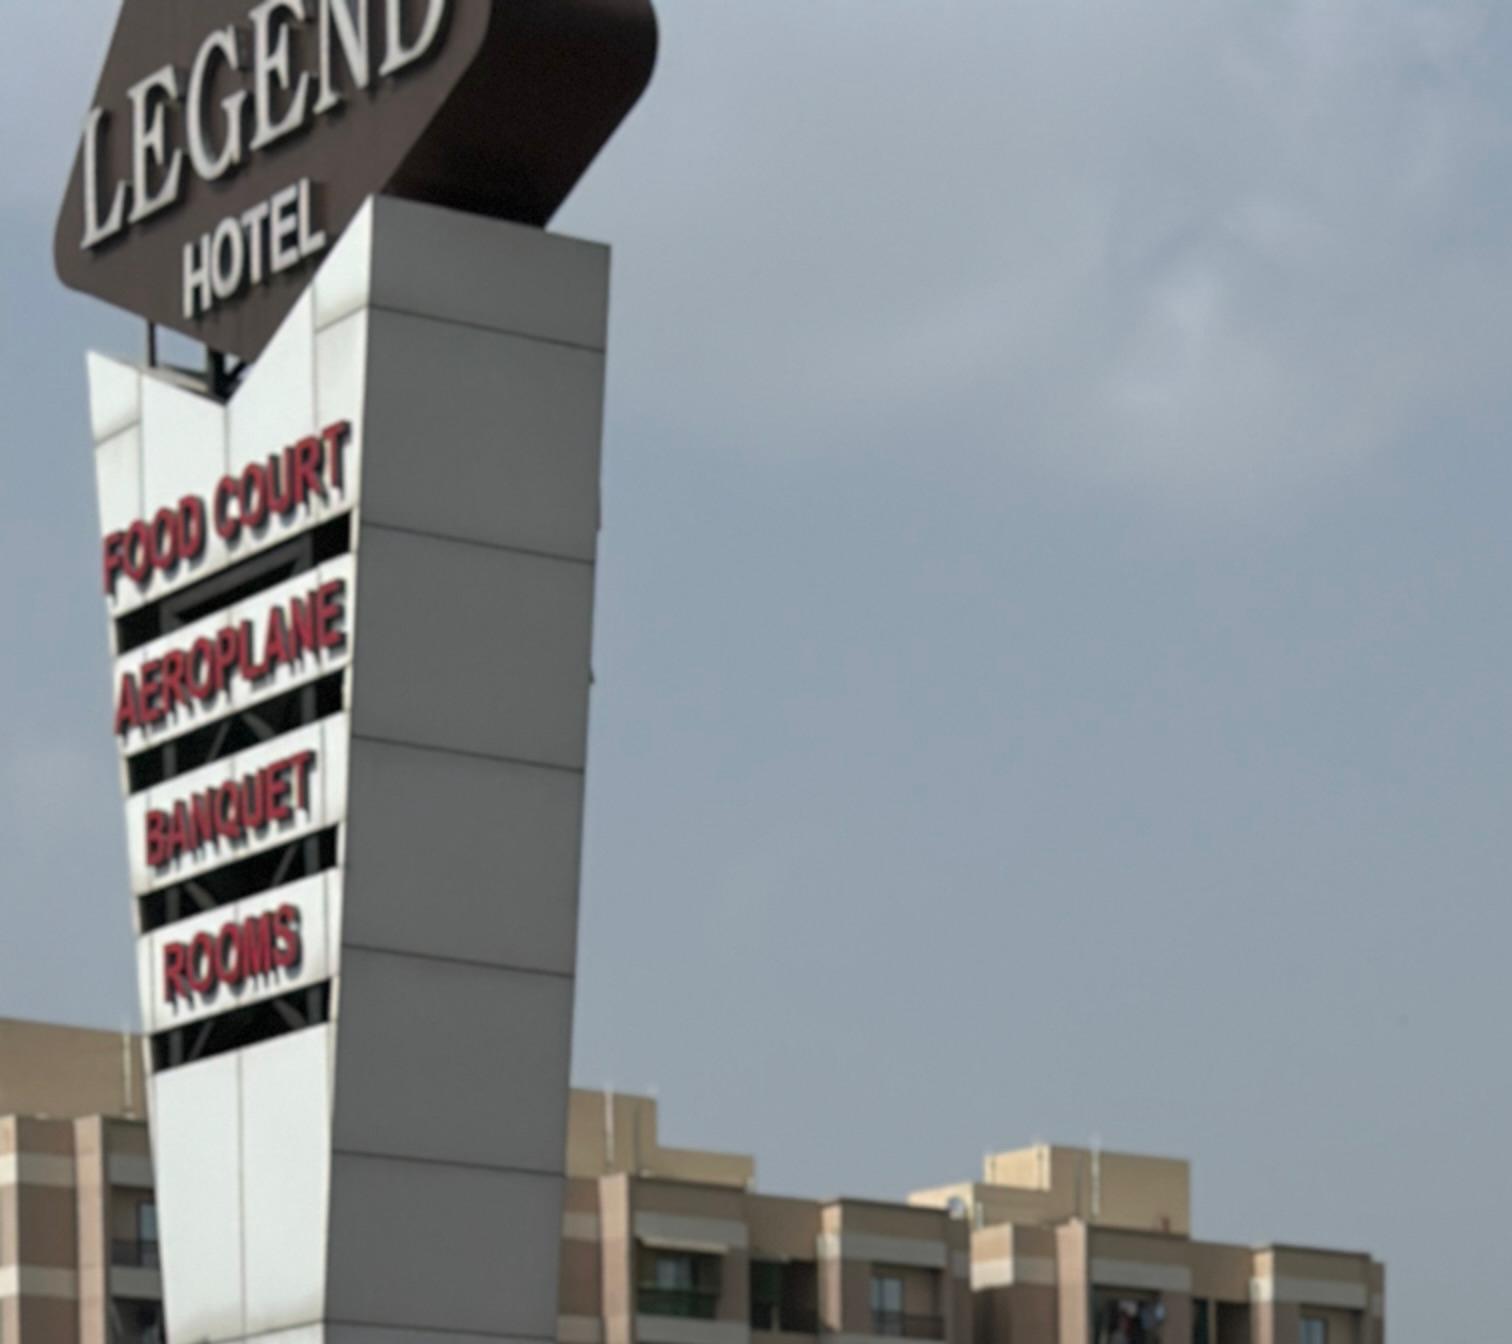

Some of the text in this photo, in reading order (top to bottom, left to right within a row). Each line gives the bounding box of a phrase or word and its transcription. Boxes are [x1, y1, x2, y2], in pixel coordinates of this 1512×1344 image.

[80, 0, 445, 250] LEGEND
[182, 177, 326, 319] HOTEL
[103, 420, 350, 597] FOOD COURT
[114, 578, 346, 736] AEROPLANE
[145, 748, 314, 868] BANQUET
[163, 903, 302, 1004] ROOMS
